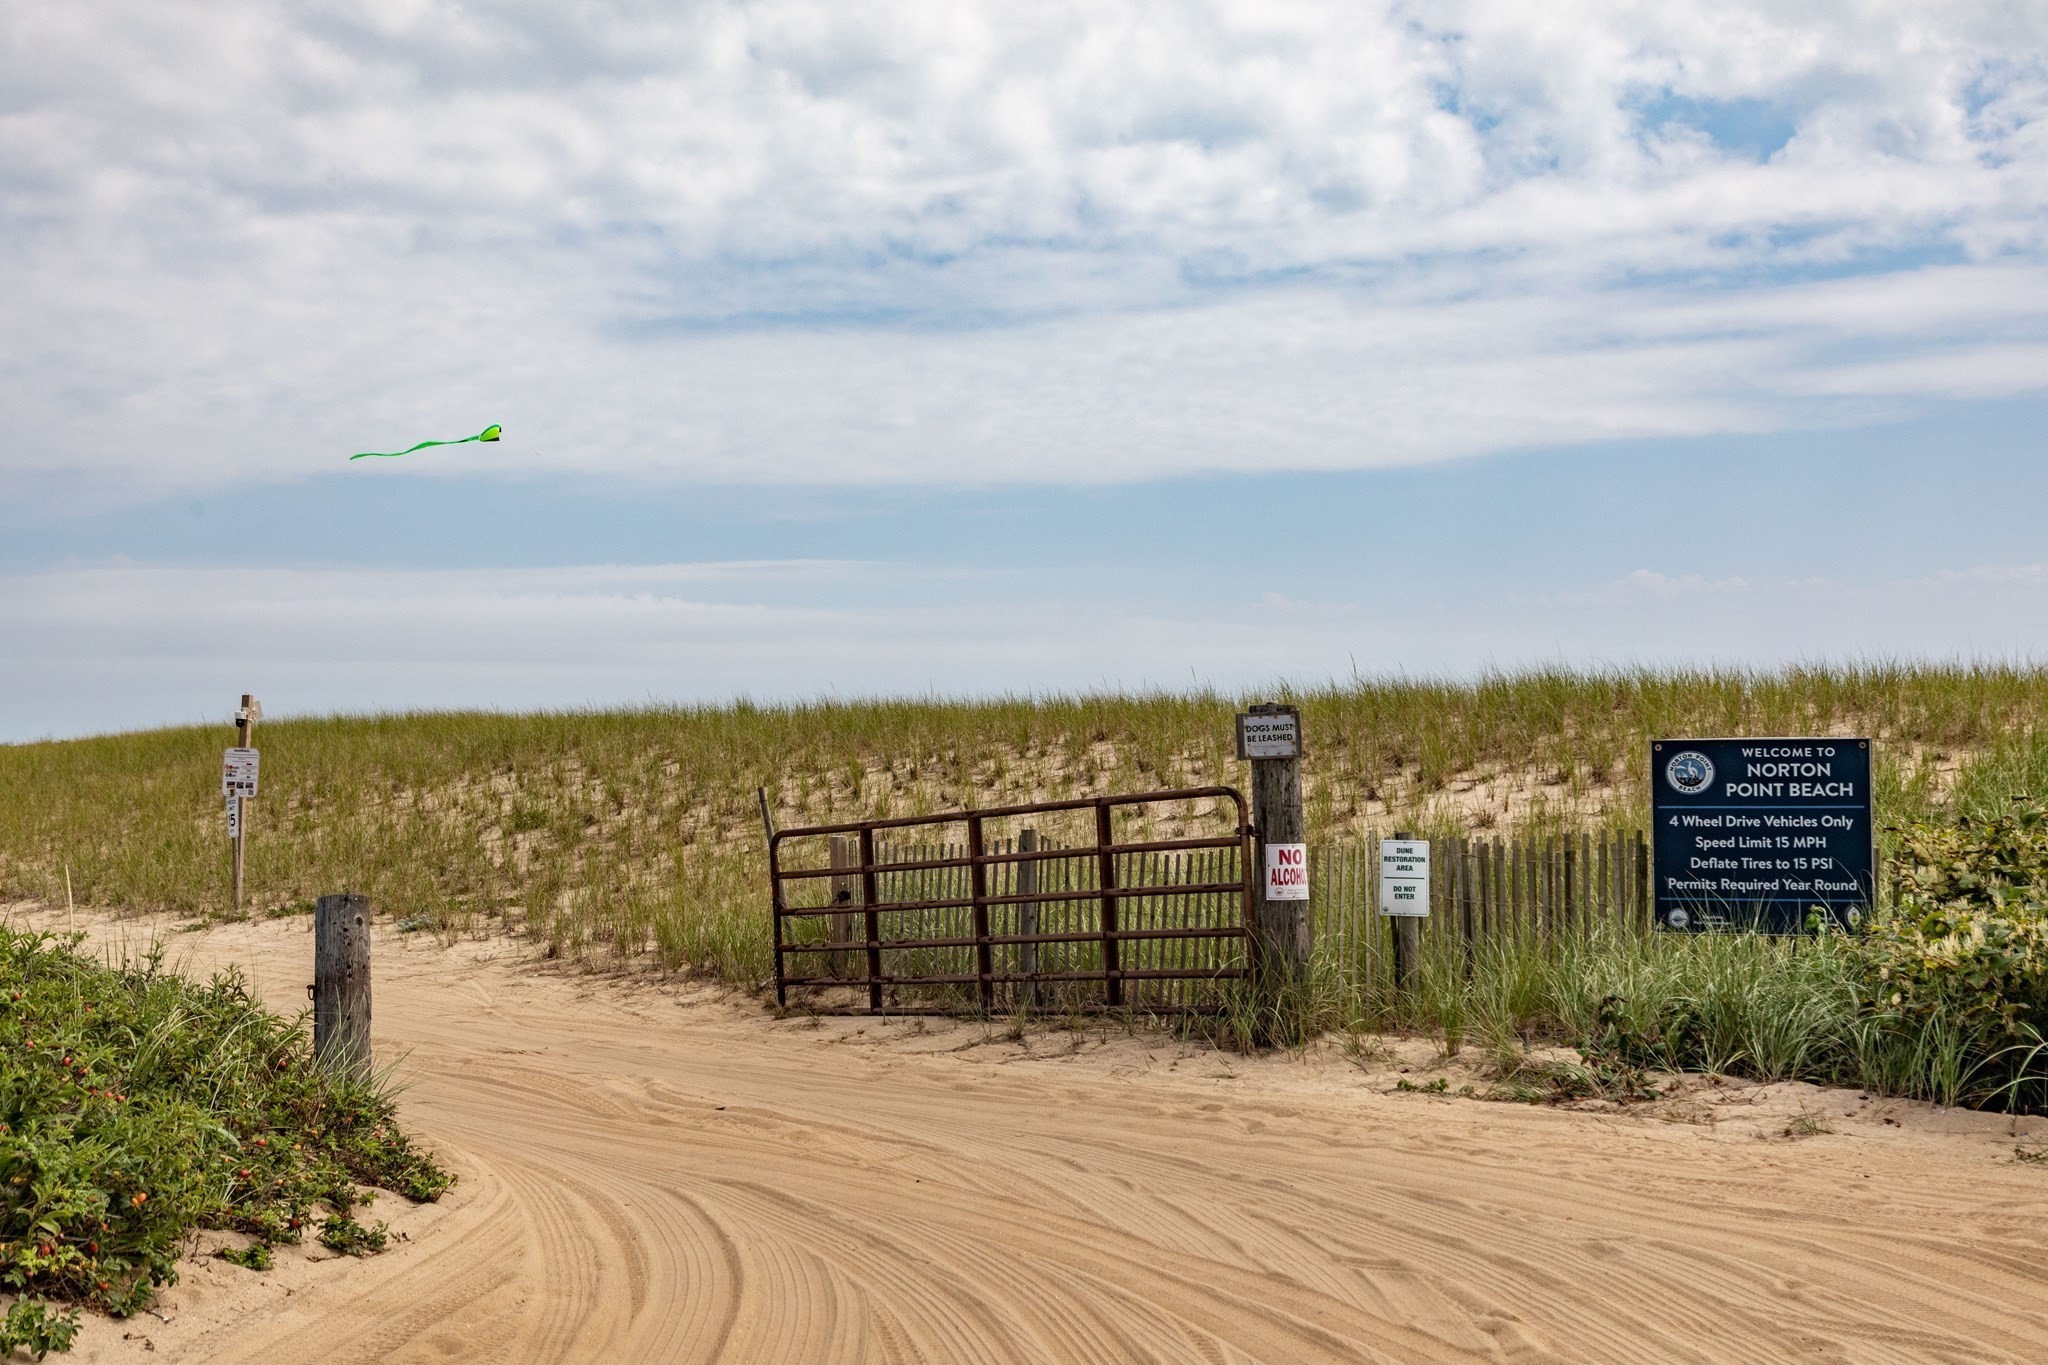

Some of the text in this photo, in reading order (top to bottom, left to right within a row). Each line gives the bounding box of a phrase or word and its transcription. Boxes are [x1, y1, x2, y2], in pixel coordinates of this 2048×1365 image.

[1246, 724, 1270, 732] DOGS
[1258, 734, 1292, 742] LEASHED
[1742, 747, 1836, 758] WELCOME TO
[1670, 754, 1712, 772] NORTON POINT
[1747, 762, 1831, 777] NORTON
[1726, 782, 1854, 797] POINT BEACH
[1669, 816, 1854, 830] 4 Wheel Drive Vehicles Only
[1696, 836, 1826, 851] Speed Limit 15 MPH
[1278, 849, 1302, 866] NO
[1690, 857, 1832, 870] Deflate Tires to 15 PSI
[1668, 878, 1857, 893] Permits Required Year Round
